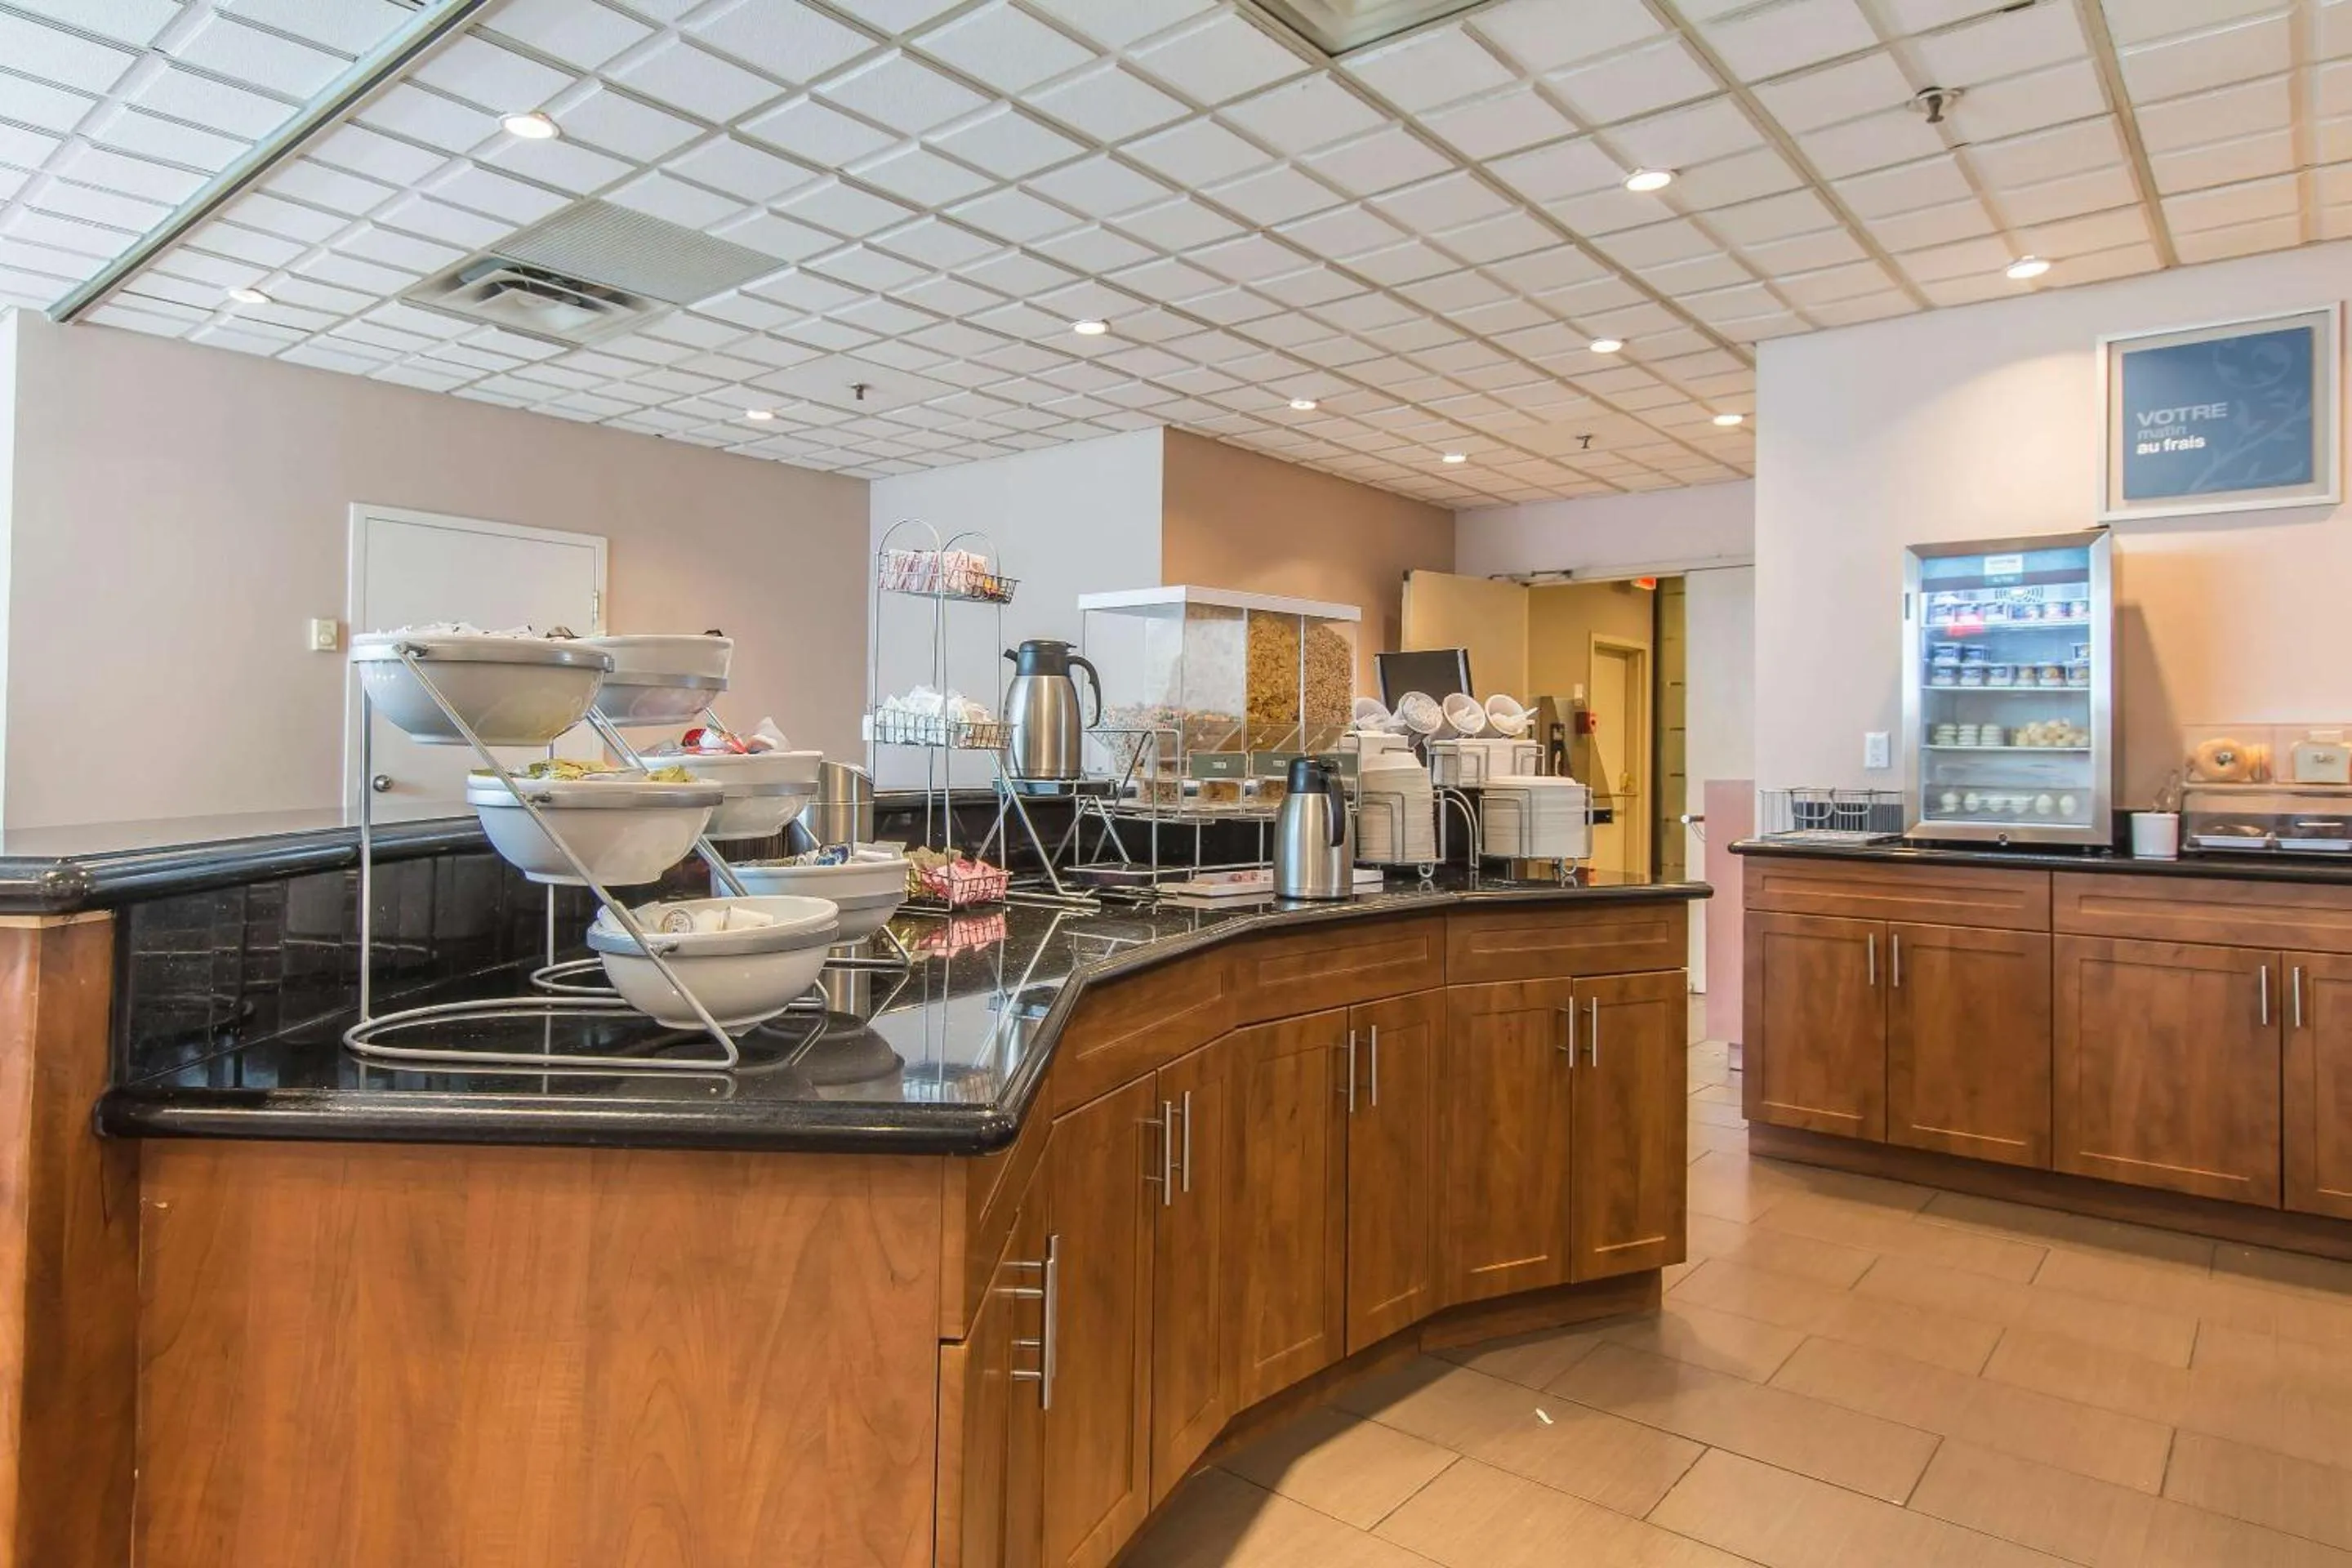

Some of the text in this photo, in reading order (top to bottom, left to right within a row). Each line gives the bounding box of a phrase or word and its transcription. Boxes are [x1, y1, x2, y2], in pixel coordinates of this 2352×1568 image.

[2136, 401, 2229, 426] VOTRE
[2137, 425, 2188, 440] matin
[2136, 435, 2207, 456] au frais
